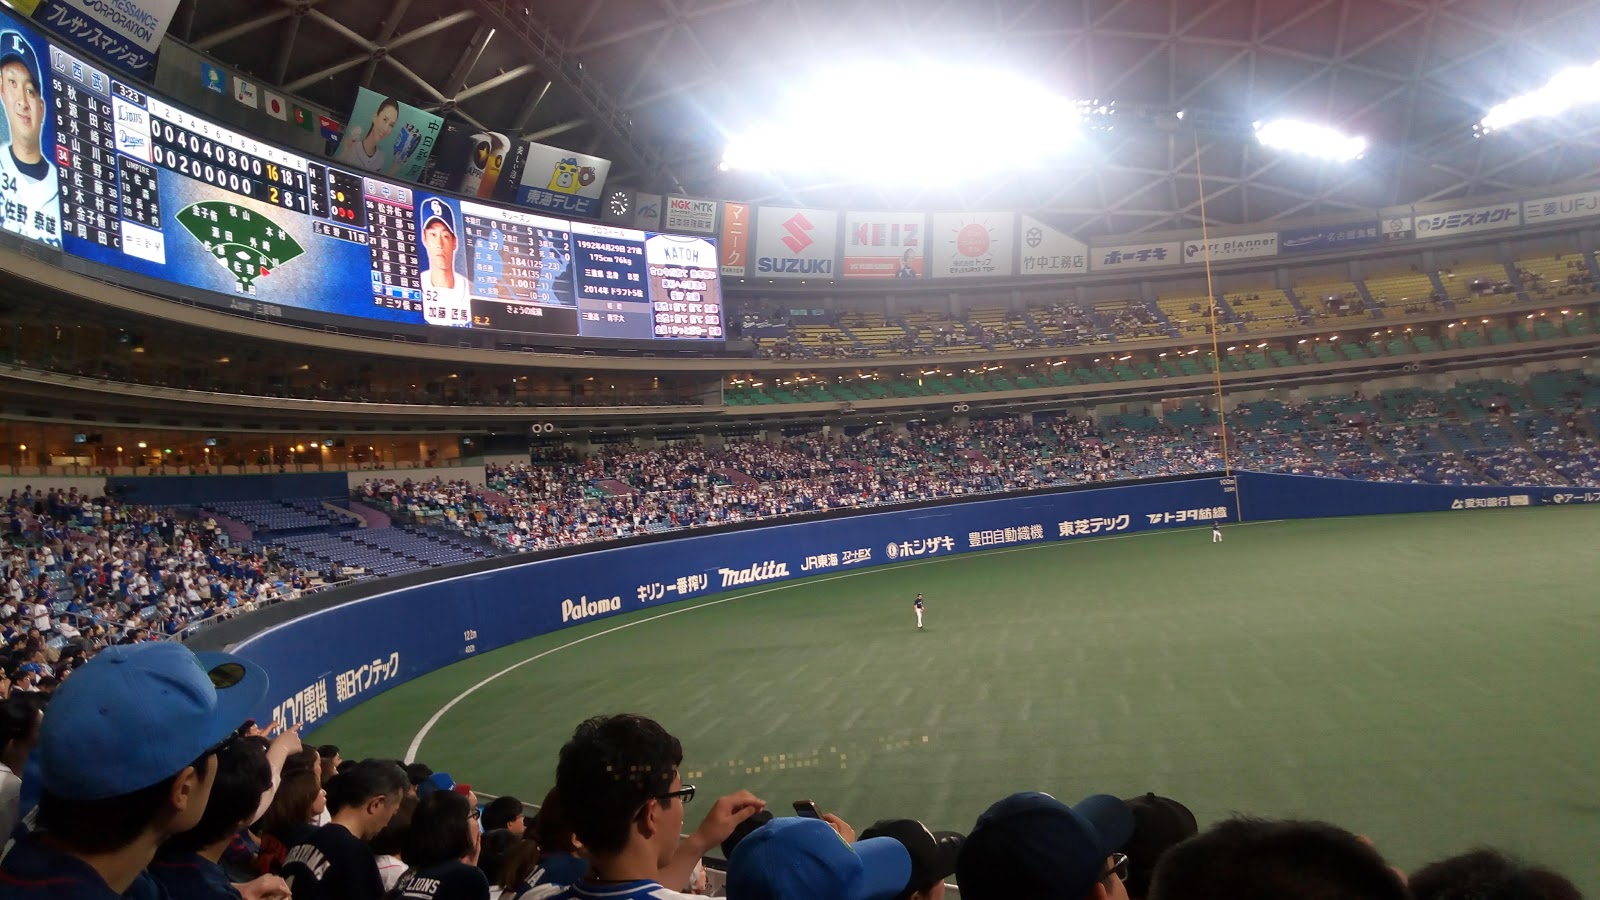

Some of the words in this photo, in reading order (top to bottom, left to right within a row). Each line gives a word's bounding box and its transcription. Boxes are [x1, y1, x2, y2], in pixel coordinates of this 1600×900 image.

[83, 0, 152, 42] ORPORATION
[47, 4, 149, 68] プレサンスマンション
[72, 60, 103, 93] 西武
[53, 79, 62, 92] 55
[120, 85, 139, 102] 3:23
[56, 98, 62, 108] 6
[57, 115, 63, 125] 5
[57, 132, 66, 144] 33
[58, 149, 67, 161] 34
[152, 120, 160, 137] 0
[165, 126, 174, 143] 0
[178, 132, 187, 148] 4
[190, 136, 199, 153] 0
[203, 142, 212, 158] 4
[215, 146, 224, 162] 0
[228, 151, 237, 167] 8
[240, 155, 249, 171] 0
[253, 160, 261, 175] 0
[266, 164, 279, 181] 16
[281, 169, 293, 186] 18
[297, 174, 303, 189] 1
[60, 167, 68, 179] 31
[126, 160, 150, 176] UMPIRE
[2, 172, 17, 194] 34
[154, 146, 162, 163] 0
[167, 151, 176, 168] 0
[179, 156, 189, 173] 2
[192, 161, 201, 177] 0
[205, 166, 214, 182] 0
[217, 170, 226, 186] 0
[230, 174, 239, 190] 0
[242, 178, 251, 194] 0
[270, 187, 279, 203] 2
[284, 192, 293, 207] 8
[299, 196, 305, 211] 1
[62, 185, 68, 196] 9
[63, 203, 70, 214] 8
[526, 189, 590, 213] 東海テレビ
[671, 199, 691, 210] NGK
[693, 202, 713, 213] NTK
[64, 220, 72, 231] 37
[1430, 207, 1518, 231] シミズオクト
[664, 247, 699, 263] KATOH
[1023, 254, 1084, 270] 竹中工務店
[1104, 247, 1168, 265] ホーチキ
[758, 256, 832, 274] SUZUKI
[426, 290, 438, 301] 52
[1465, 496, 1508, 509] 愛知銀行
[1164, 506, 1227, 523] トヨタ紡織
[1058, 514, 1130, 537] 東芝テック
[968, 524, 1044, 547] 豊田自動織機
[900, 536, 955, 557] ホシザキ
[801, 553, 838, 571] JR東海
[637, 573, 708, 602] キリン一番搾り
[561, 596, 621, 623] Paloma
[336, 652, 399, 702] 朝日インテック
[406, 877, 440, 894] LIONS
